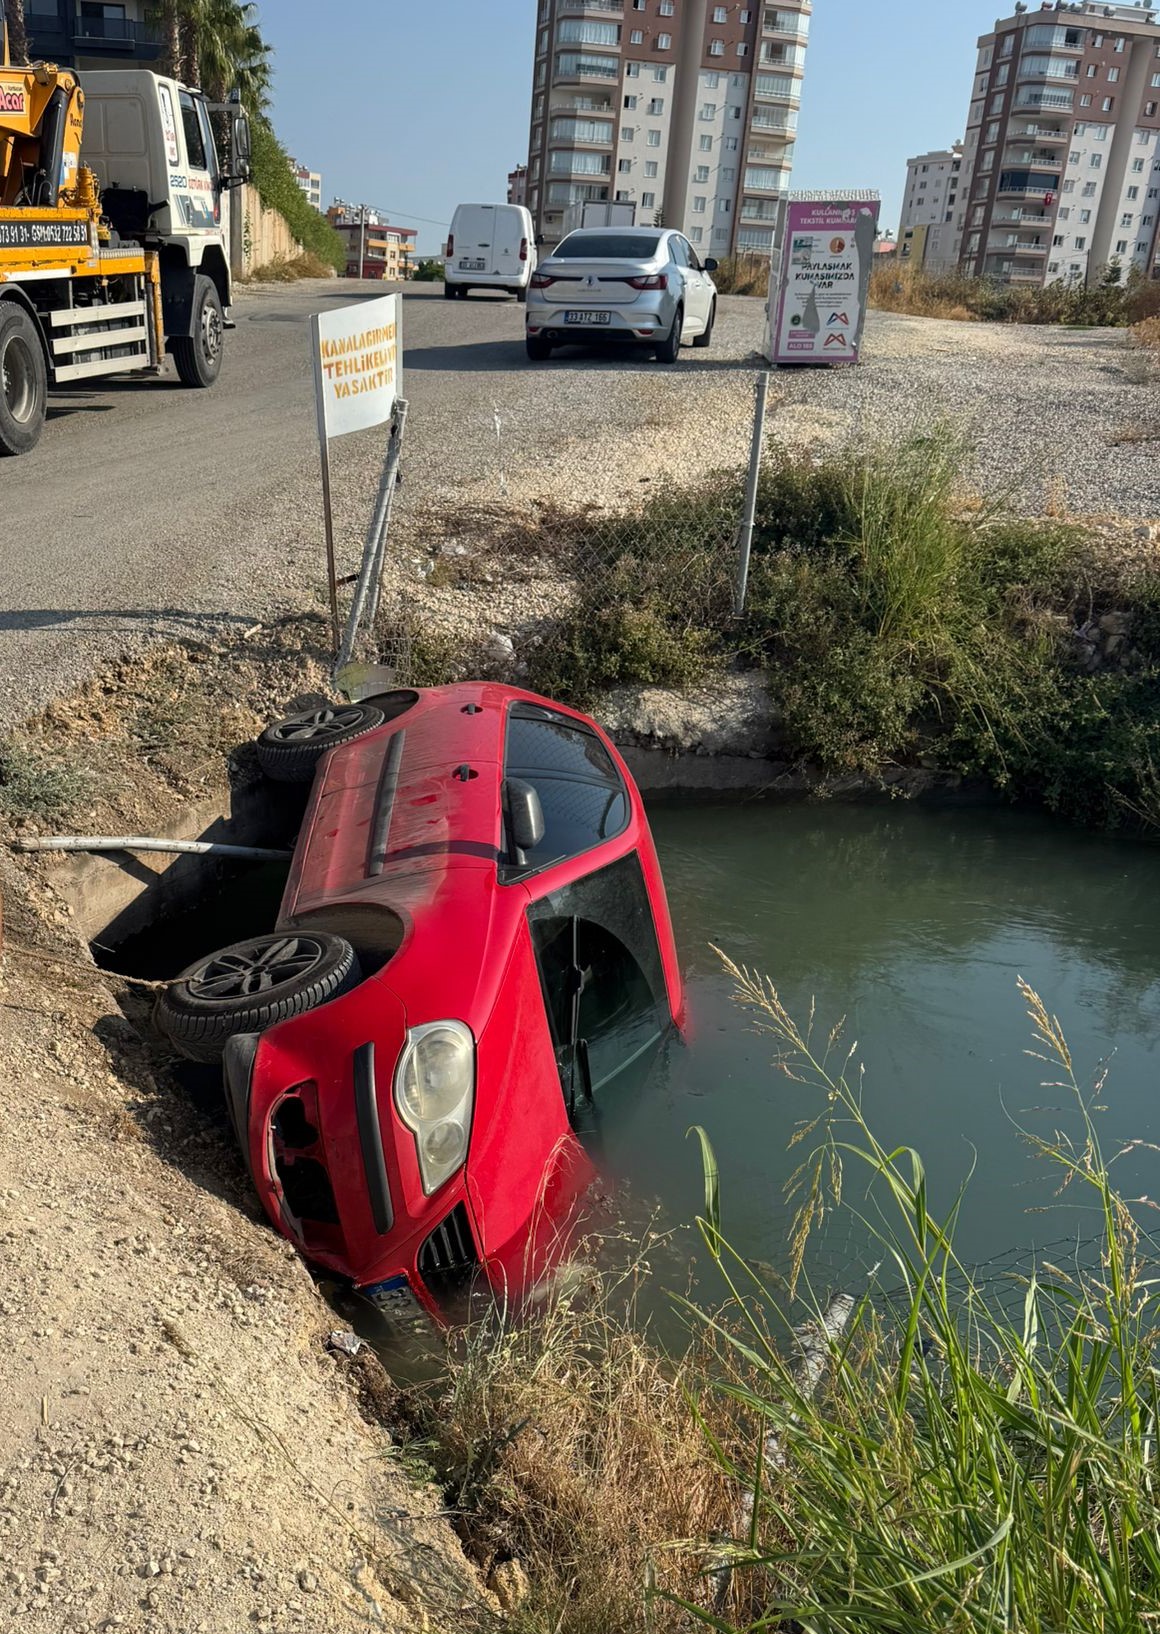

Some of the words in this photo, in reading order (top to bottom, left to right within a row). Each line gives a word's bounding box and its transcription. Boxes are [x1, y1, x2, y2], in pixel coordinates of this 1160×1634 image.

[170, 174, 187, 188] 2520
[62, 225, 72, 242] 722
[568, 312, 578, 321] 33
